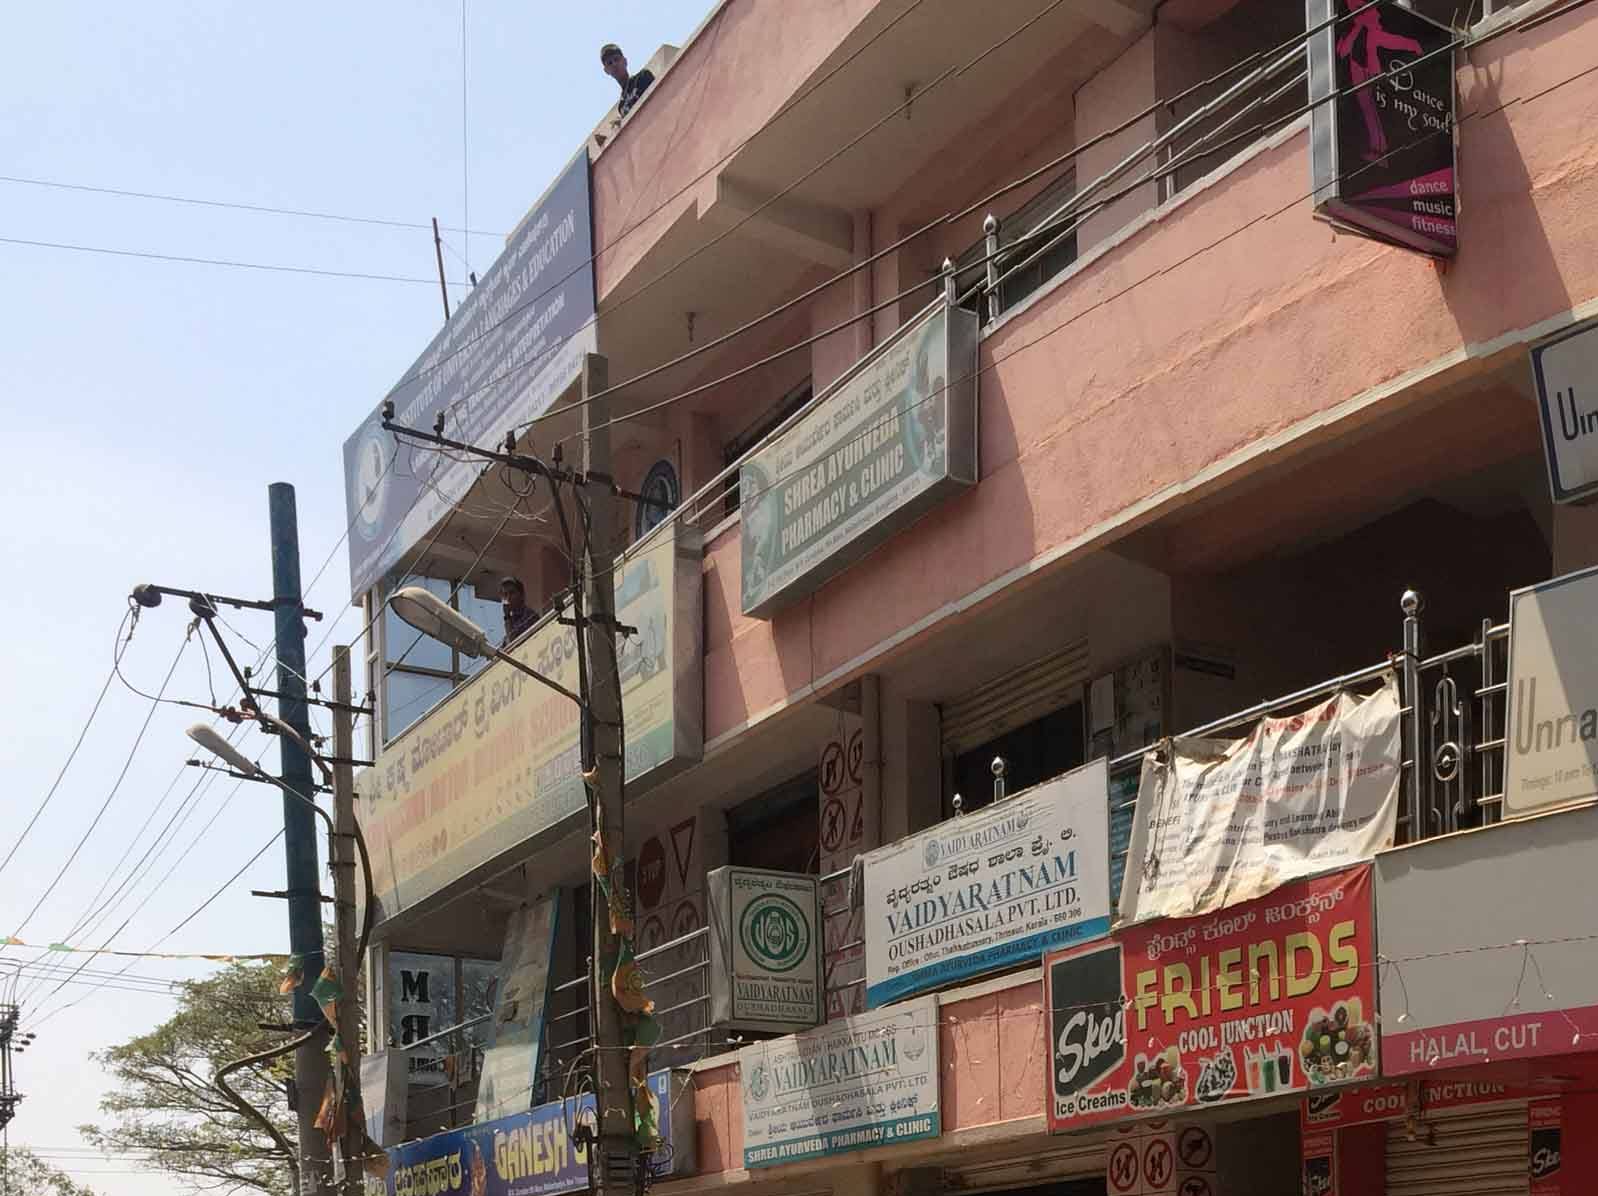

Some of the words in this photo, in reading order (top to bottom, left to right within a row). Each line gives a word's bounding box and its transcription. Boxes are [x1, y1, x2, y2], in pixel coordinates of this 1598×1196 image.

[1409, 179, 1449, 195] dance
[1413, 199, 1453, 217] music
[886, 850, 1079, 937] VAIDYARATNAM
[1045, 886, 1082, 913] LTD.
[1135, 919, 1361, 1032] FRIENDS
[1178, 1026, 1219, 1053] COOL
[1220, 1007, 1295, 1045] JUNCTION
[1493, 1022, 1543, 1052] CUT
[1055, 1097, 1075, 1116] Ice
[1076, 1088, 1128, 1113] Creams
[895, 1117, 932, 1136] CLINIC
